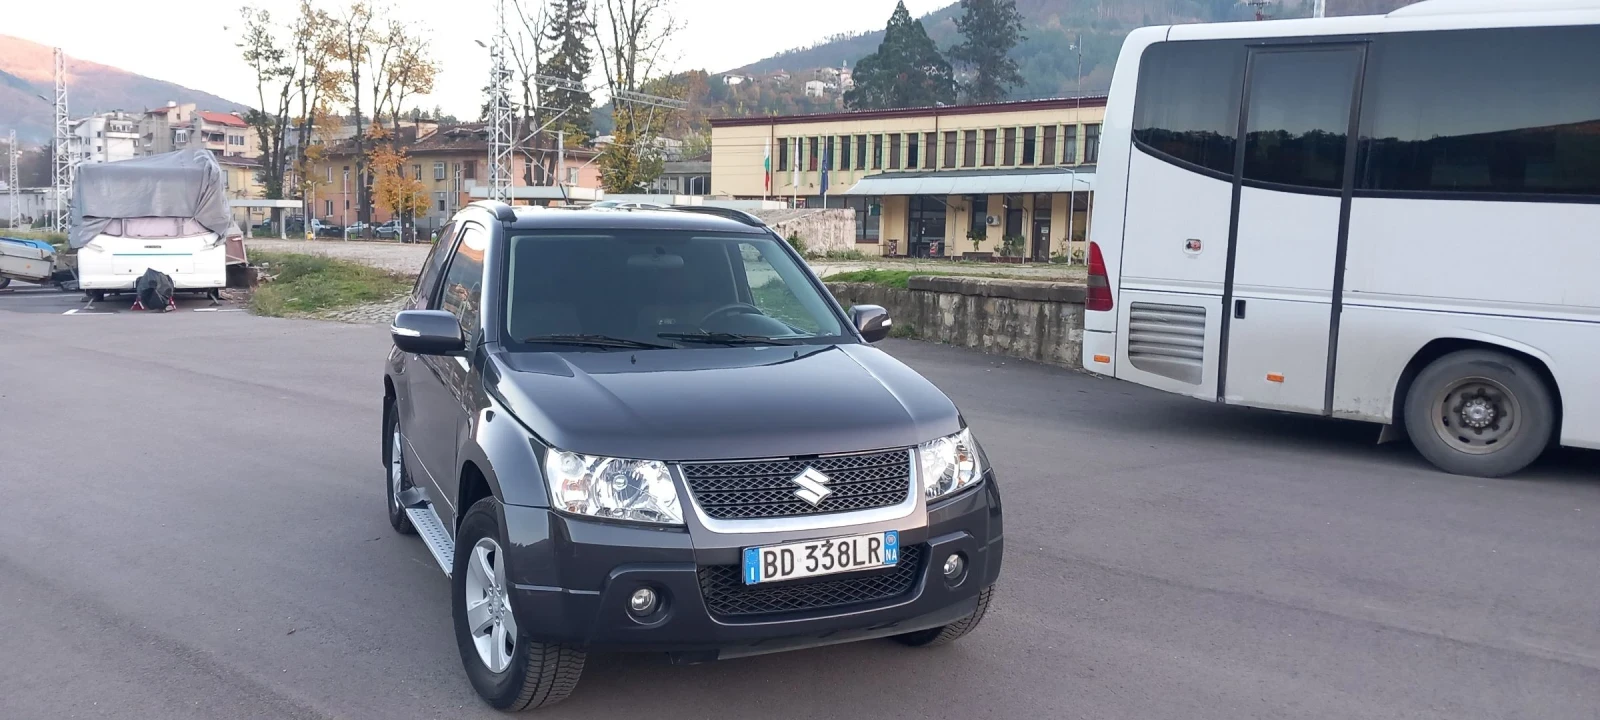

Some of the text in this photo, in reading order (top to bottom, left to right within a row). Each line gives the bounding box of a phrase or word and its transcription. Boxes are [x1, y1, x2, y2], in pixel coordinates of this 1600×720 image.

[764, 548, 794, 579] BD
[805, 537, 881, 573] 338LR
[886, 549, 898, 561] NA
